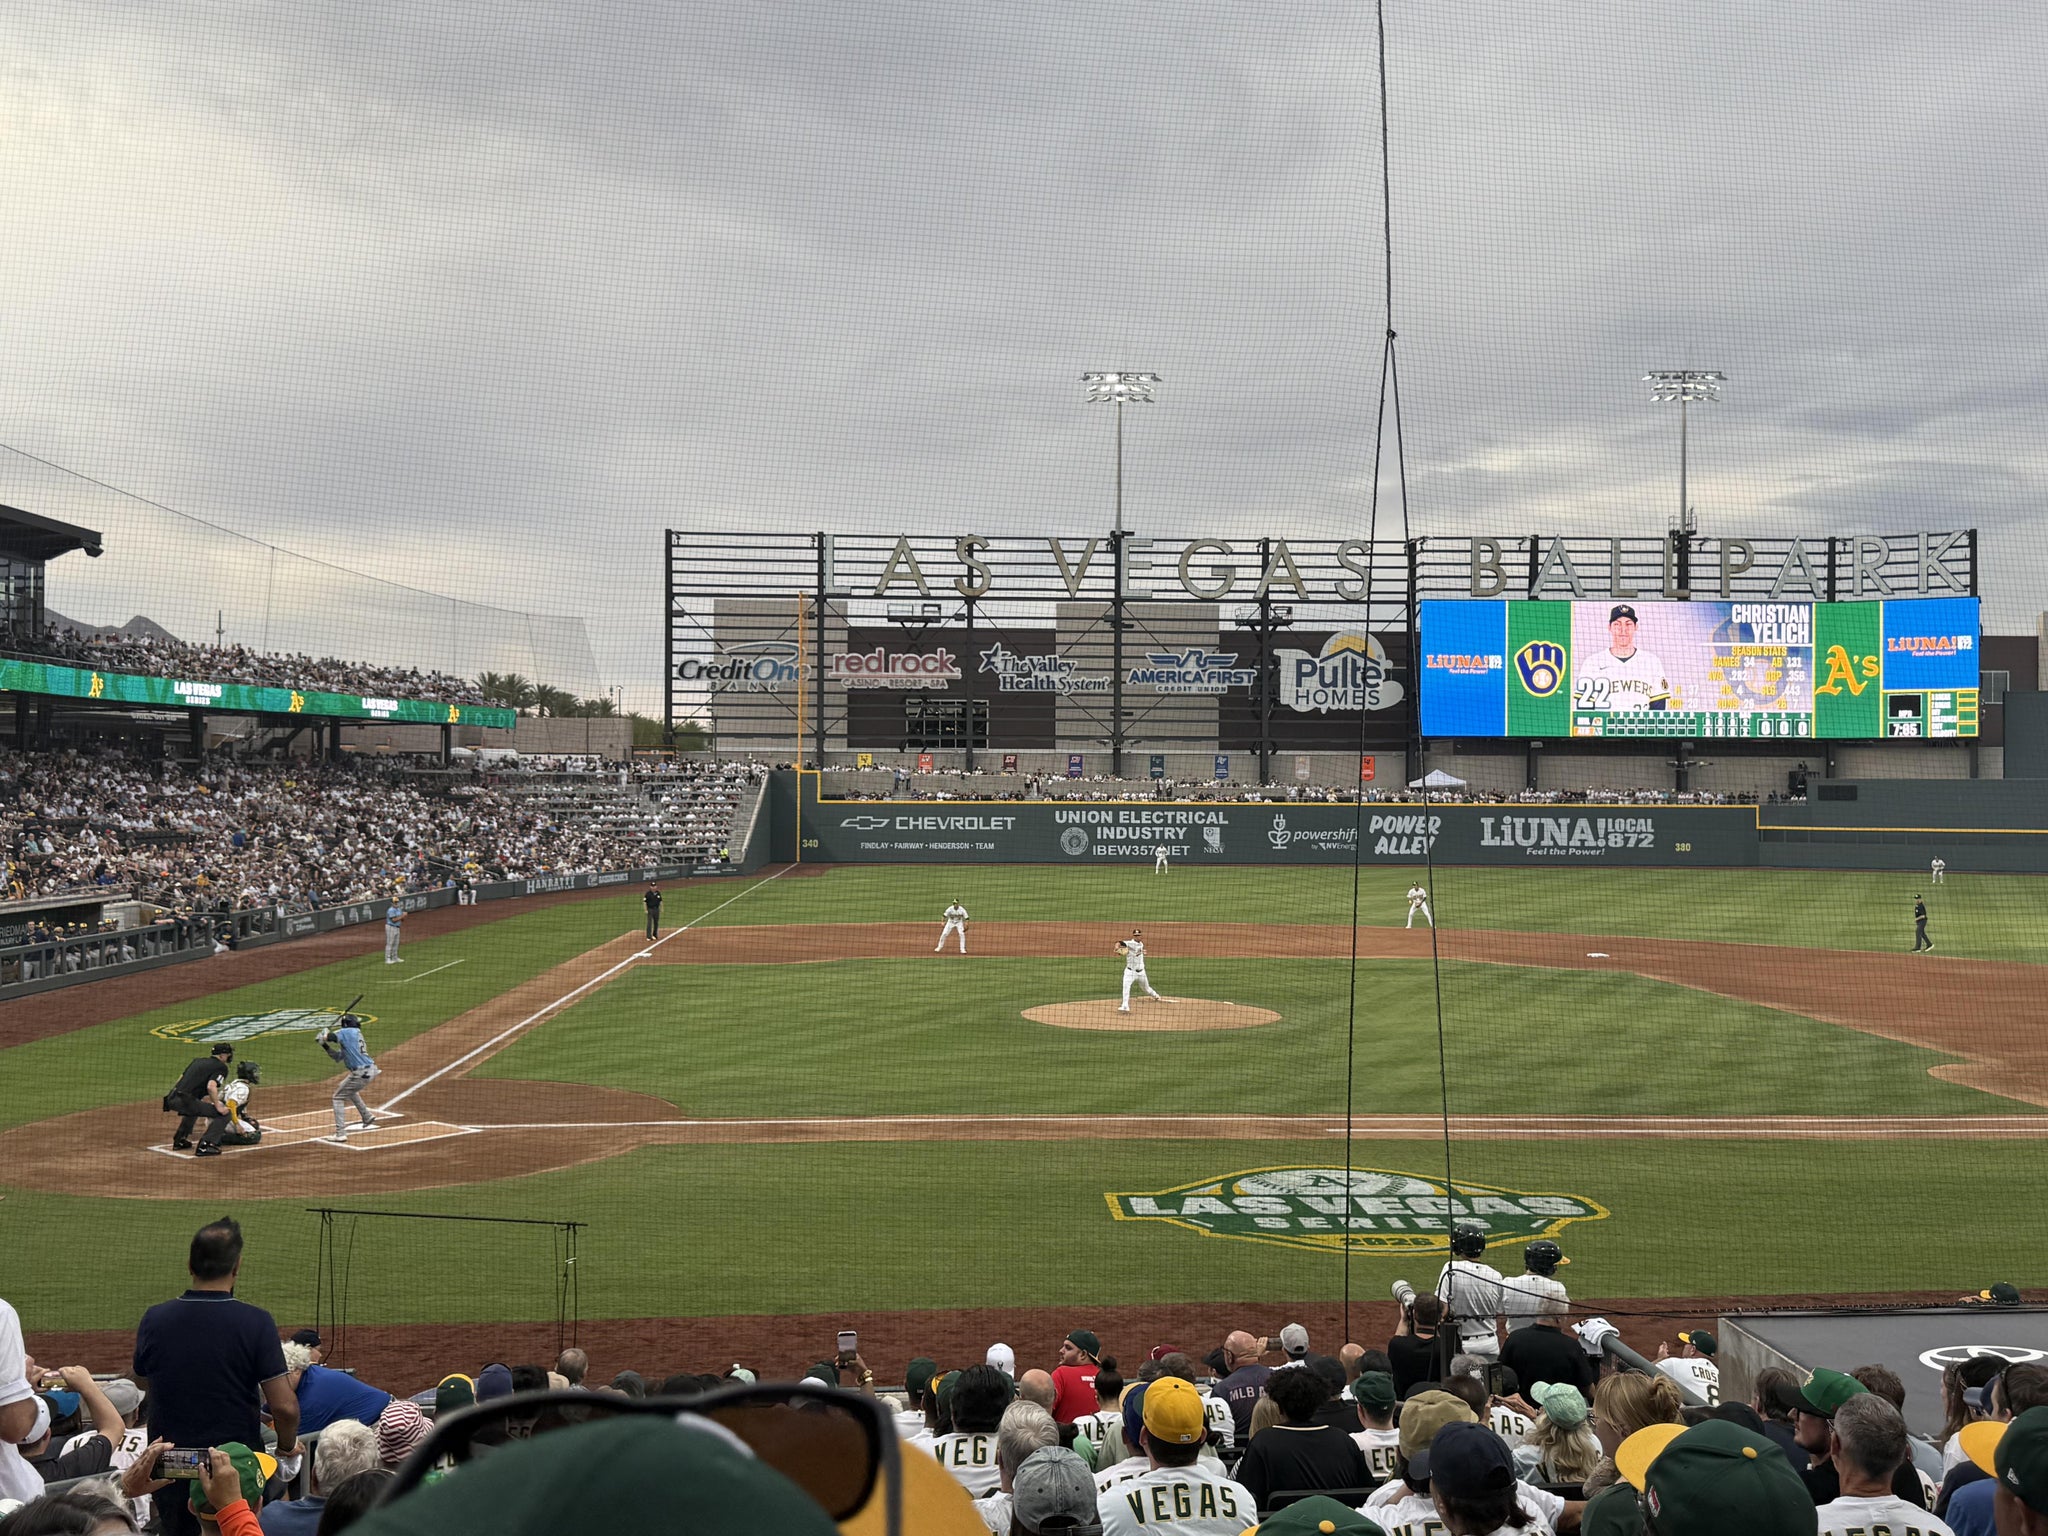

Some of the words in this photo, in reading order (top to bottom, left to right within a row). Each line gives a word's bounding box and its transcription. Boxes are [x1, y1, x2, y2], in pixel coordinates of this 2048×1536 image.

[825, 533, 992, 597] LAS
[1048, 536, 1371, 600] VEGAS
[1470, 529, 1968, 598] BALLPARK
[1731, 604, 1809, 623] CHRISTIAN
[1751, 623, 1809, 643] YELICH
[1731, 646, 1762, 656] SEASON
[1763, 646, 1787, 656] STATS
[834, 650, 883, 673] red
[890, 650, 956, 673] rock
[1002, 657, 1028, 673] The
[1027, 656, 1077, 678] Valley
[1815, 644, 1879, 696] A's
[1127, 670, 1204, 684] AMERICA
[1206, 670, 1256, 684] FIRST
[1295, 655, 1382, 688] Pulte
[709, 681, 778, 692] BANK
[1000, 675, 1057, 690] Health
[1057, 677, 1107, 694] System
[1577, 677, 1611, 709] 22
[1295, 689, 1380, 706] HOMES
[895, 816, 1016, 830] CHEVROLET
[1055, 811, 1113, 824] UNION
[1119, 811, 1229, 825] ELECTRICAL
[1369, 815, 1442, 834] POWER
[1607, 818, 1655, 833] LOCAL
[1096, 827, 1187, 839] INDUSTRY
[1480, 816, 1606, 847] LiUNA!
[1607, 833, 1655, 848] 872
[802, 839, 819, 848] 340
[860, 842, 889, 850] FINDLAY
[894, 842, 923, 850] FAIRWAY
[929, 842, 970, 850] HENDERSON
[975, 842, 995, 850] TEAM
[1093, 845, 1190, 856] IBEW357NET
[1375, 835, 1436, 855] ALLEY
[1526, 848, 1547, 856] Feel
[1549, 848, 1566, 856] the
[1568, 848, 1605, 856] Power!
[1128, 1196, 1293, 1215] LAS
[1296, 1196, 1586, 1216] VEGAS
[1253, 1217, 1492, 1229] SERIES
[1229, 1386, 1256, 1402] MLB
[934, 1434, 1000, 1467] VEG
[1125, 1481, 1238, 1526] VEGAS
